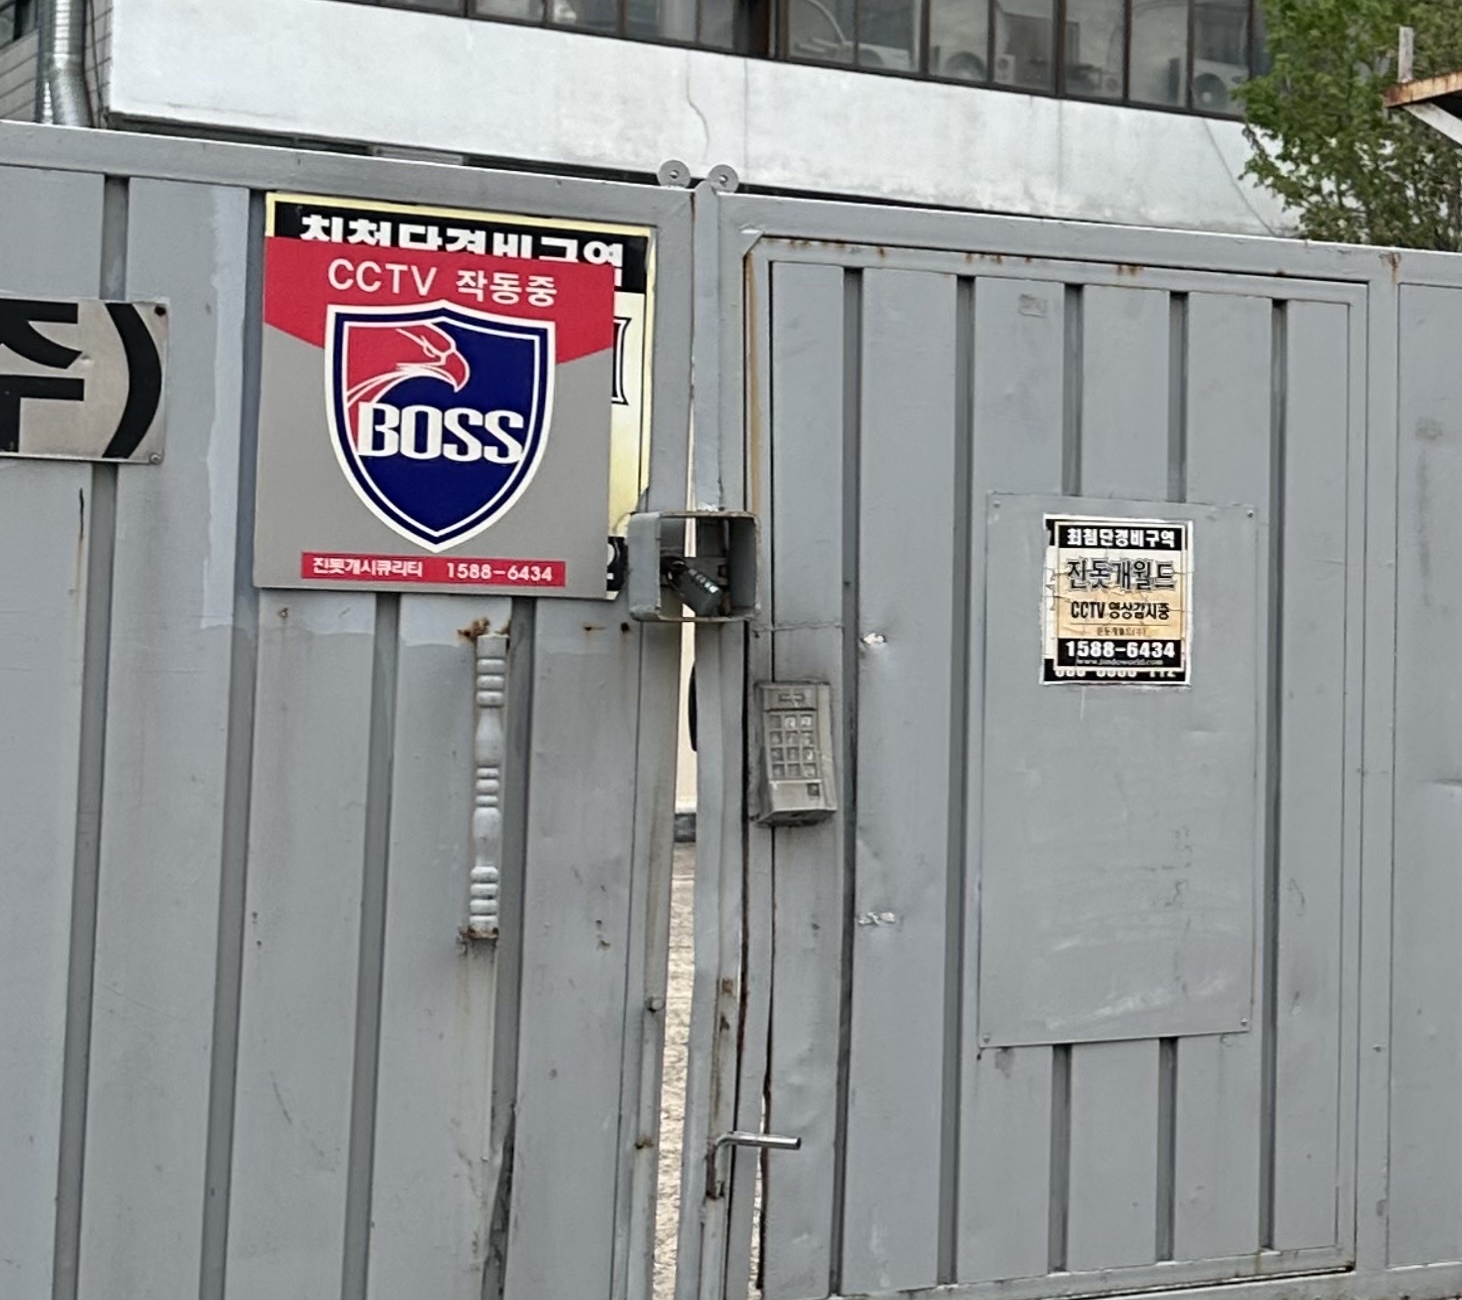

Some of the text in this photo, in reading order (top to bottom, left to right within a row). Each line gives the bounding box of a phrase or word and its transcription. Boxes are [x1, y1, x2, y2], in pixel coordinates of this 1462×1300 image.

[327, 258, 558, 308] CCTV 작동중
[355, 401, 527, 465] BOSS
[1066, 527, 1176, 549] 최첨단경비구역
[312, 556, 553, 582] 진돗개시큐리티 1588-6434
[1066, 557, 1177, 592] 진돗개월드
[1070, 600, 1171, 620] CCTV 영상감시중
[1065, 640, 1176, 659] 1588-6434
